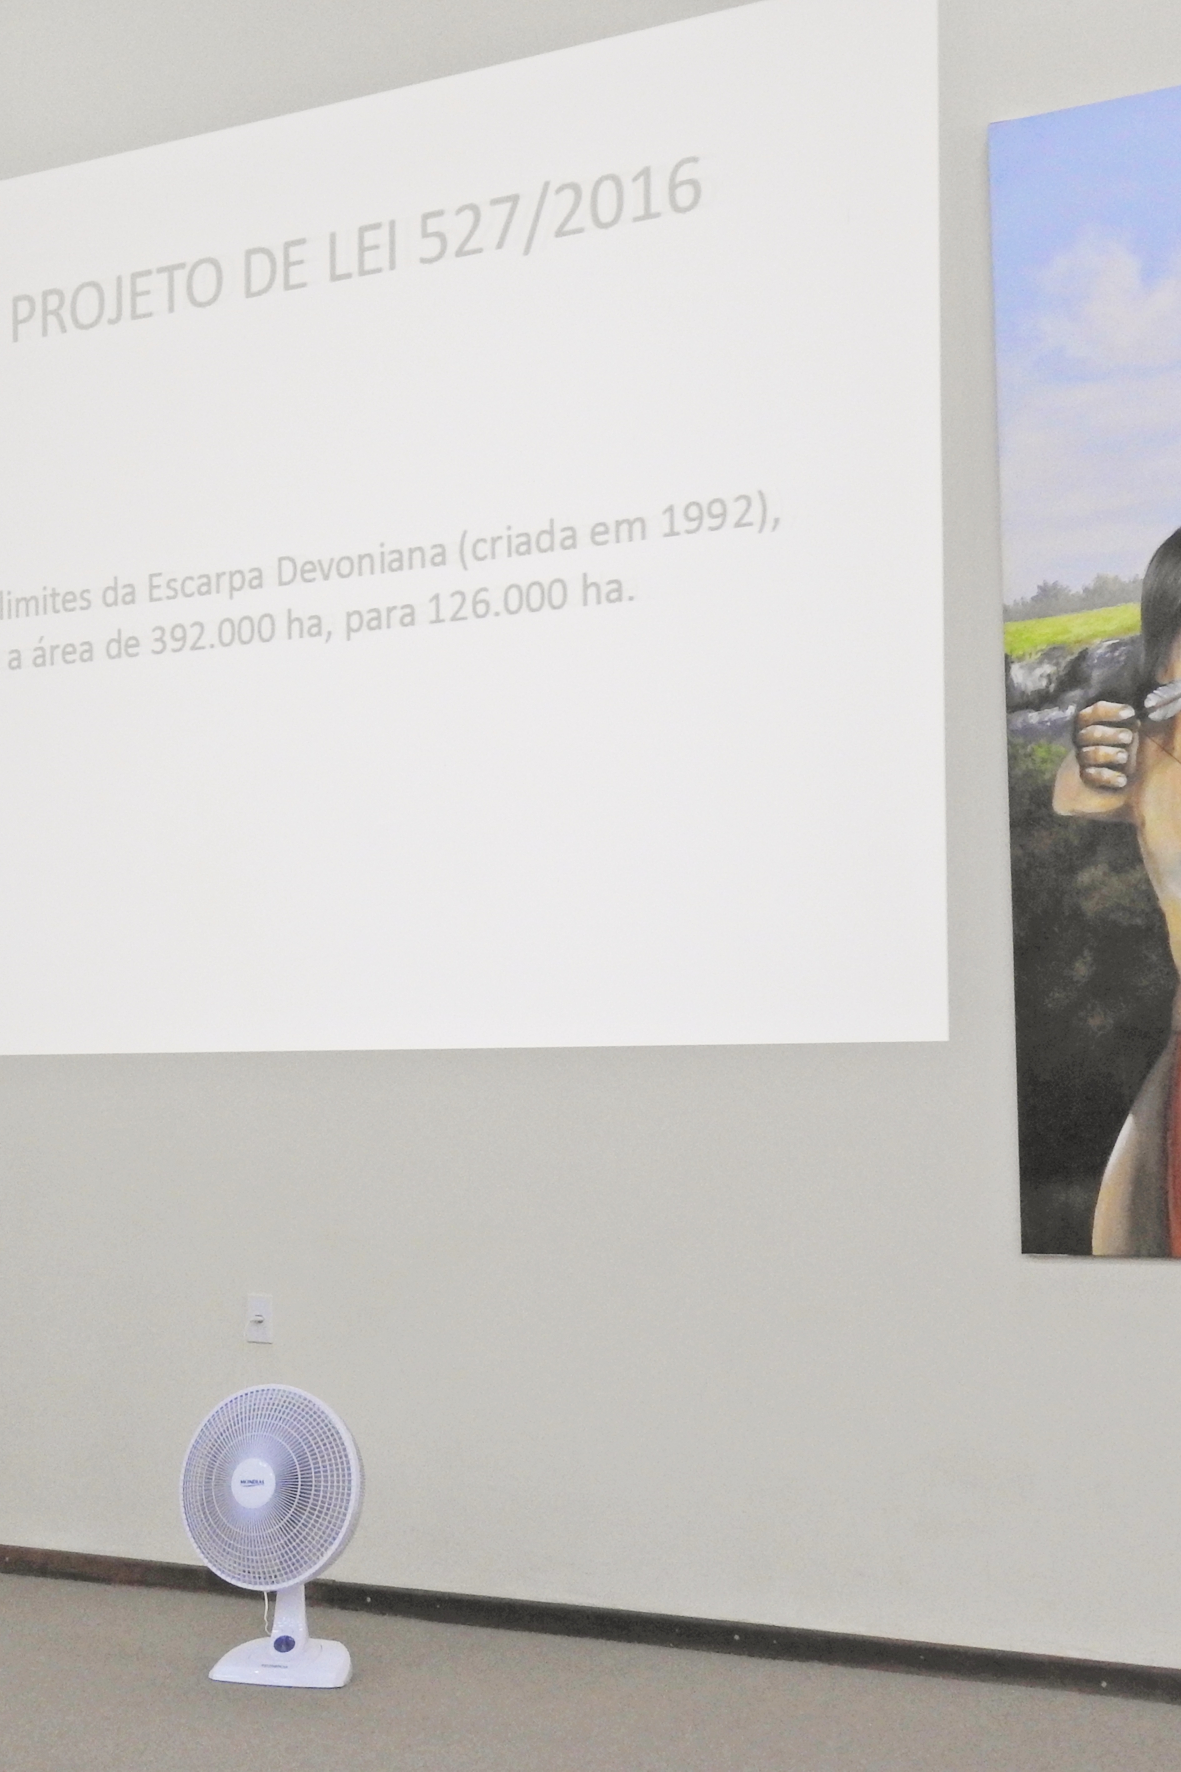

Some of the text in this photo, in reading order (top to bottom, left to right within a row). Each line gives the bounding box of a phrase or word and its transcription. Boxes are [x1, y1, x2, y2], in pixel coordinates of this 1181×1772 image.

[10, 155, 703, 343] PROJETO DE LEI 527/2016
[101, 576, 136, 608] da
[147, 565, 264, 603] Escarpa
[276, 542, 447, 588] Devoniana
[458, 518, 578, 572] (criada
[589, 516, 647, 547] em
[661, 489, 782, 538] 1992),
[7, 648, 22, 671] a
[32, 636, 94, 668] área
[105, 628, 141, 660] de
[150, 612, 276, 655] 392.000
[286, 608, 333, 643] ha,
[344, 603, 416, 640] para
[427, 577, 568, 625] 126.000
[581, 572, 636, 607] ha.
